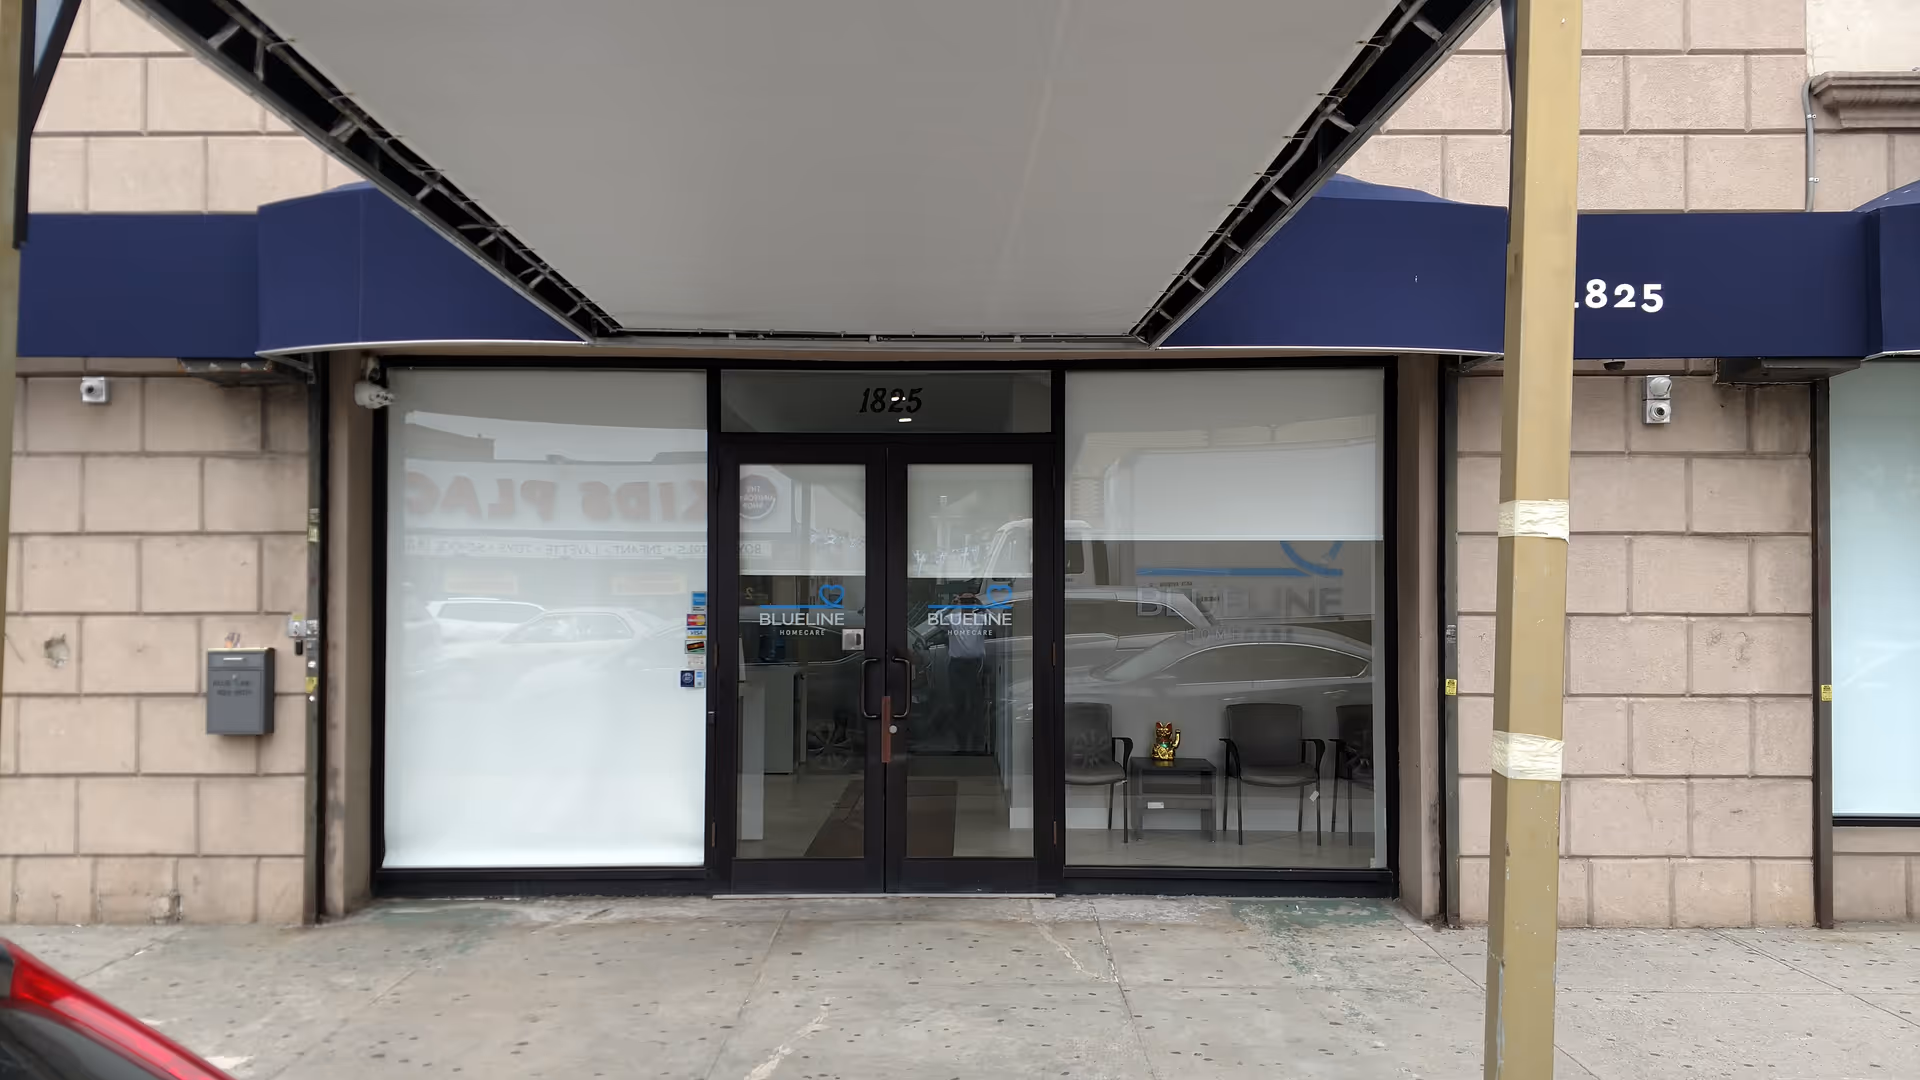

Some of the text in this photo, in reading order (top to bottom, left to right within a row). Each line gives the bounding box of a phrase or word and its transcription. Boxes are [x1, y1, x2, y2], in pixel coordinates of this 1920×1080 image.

[1574, 278, 1664, 313] 825
[859, 387, 923, 413] 1825
[759, 612, 845, 627] BLUELINE
[927, 612, 1013, 627] BLUELINE
